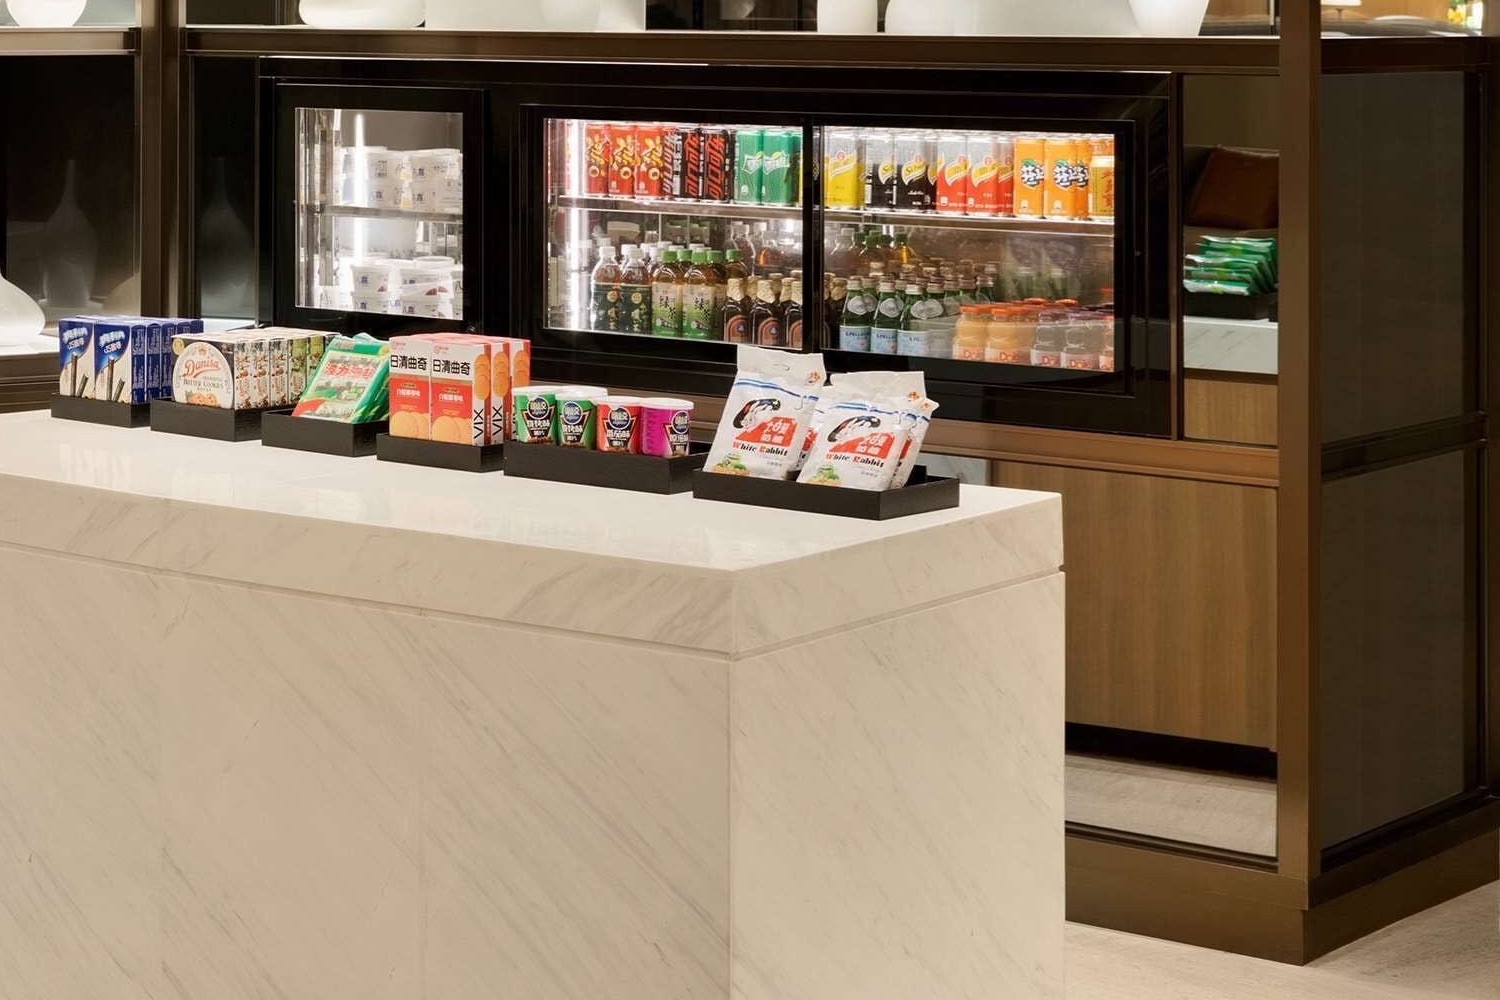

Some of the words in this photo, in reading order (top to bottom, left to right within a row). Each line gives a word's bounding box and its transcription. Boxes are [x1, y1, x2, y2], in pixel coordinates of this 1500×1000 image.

[706, 132, 725, 199] 可口可乐
[180, 357, 220, 377] Danisa
[390, 355, 427, 371] 日清曲奇
[433, 359, 471, 376] 日清曲奇
[473, 408, 484, 439] VIX
[492, 406, 503, 436] VIX
[733, 441, 757, 453] White
[759, 445, 788, 457] Rabbit
[826, 453, 850, 462] White
[853, 455, 884, 468] Rabbit
